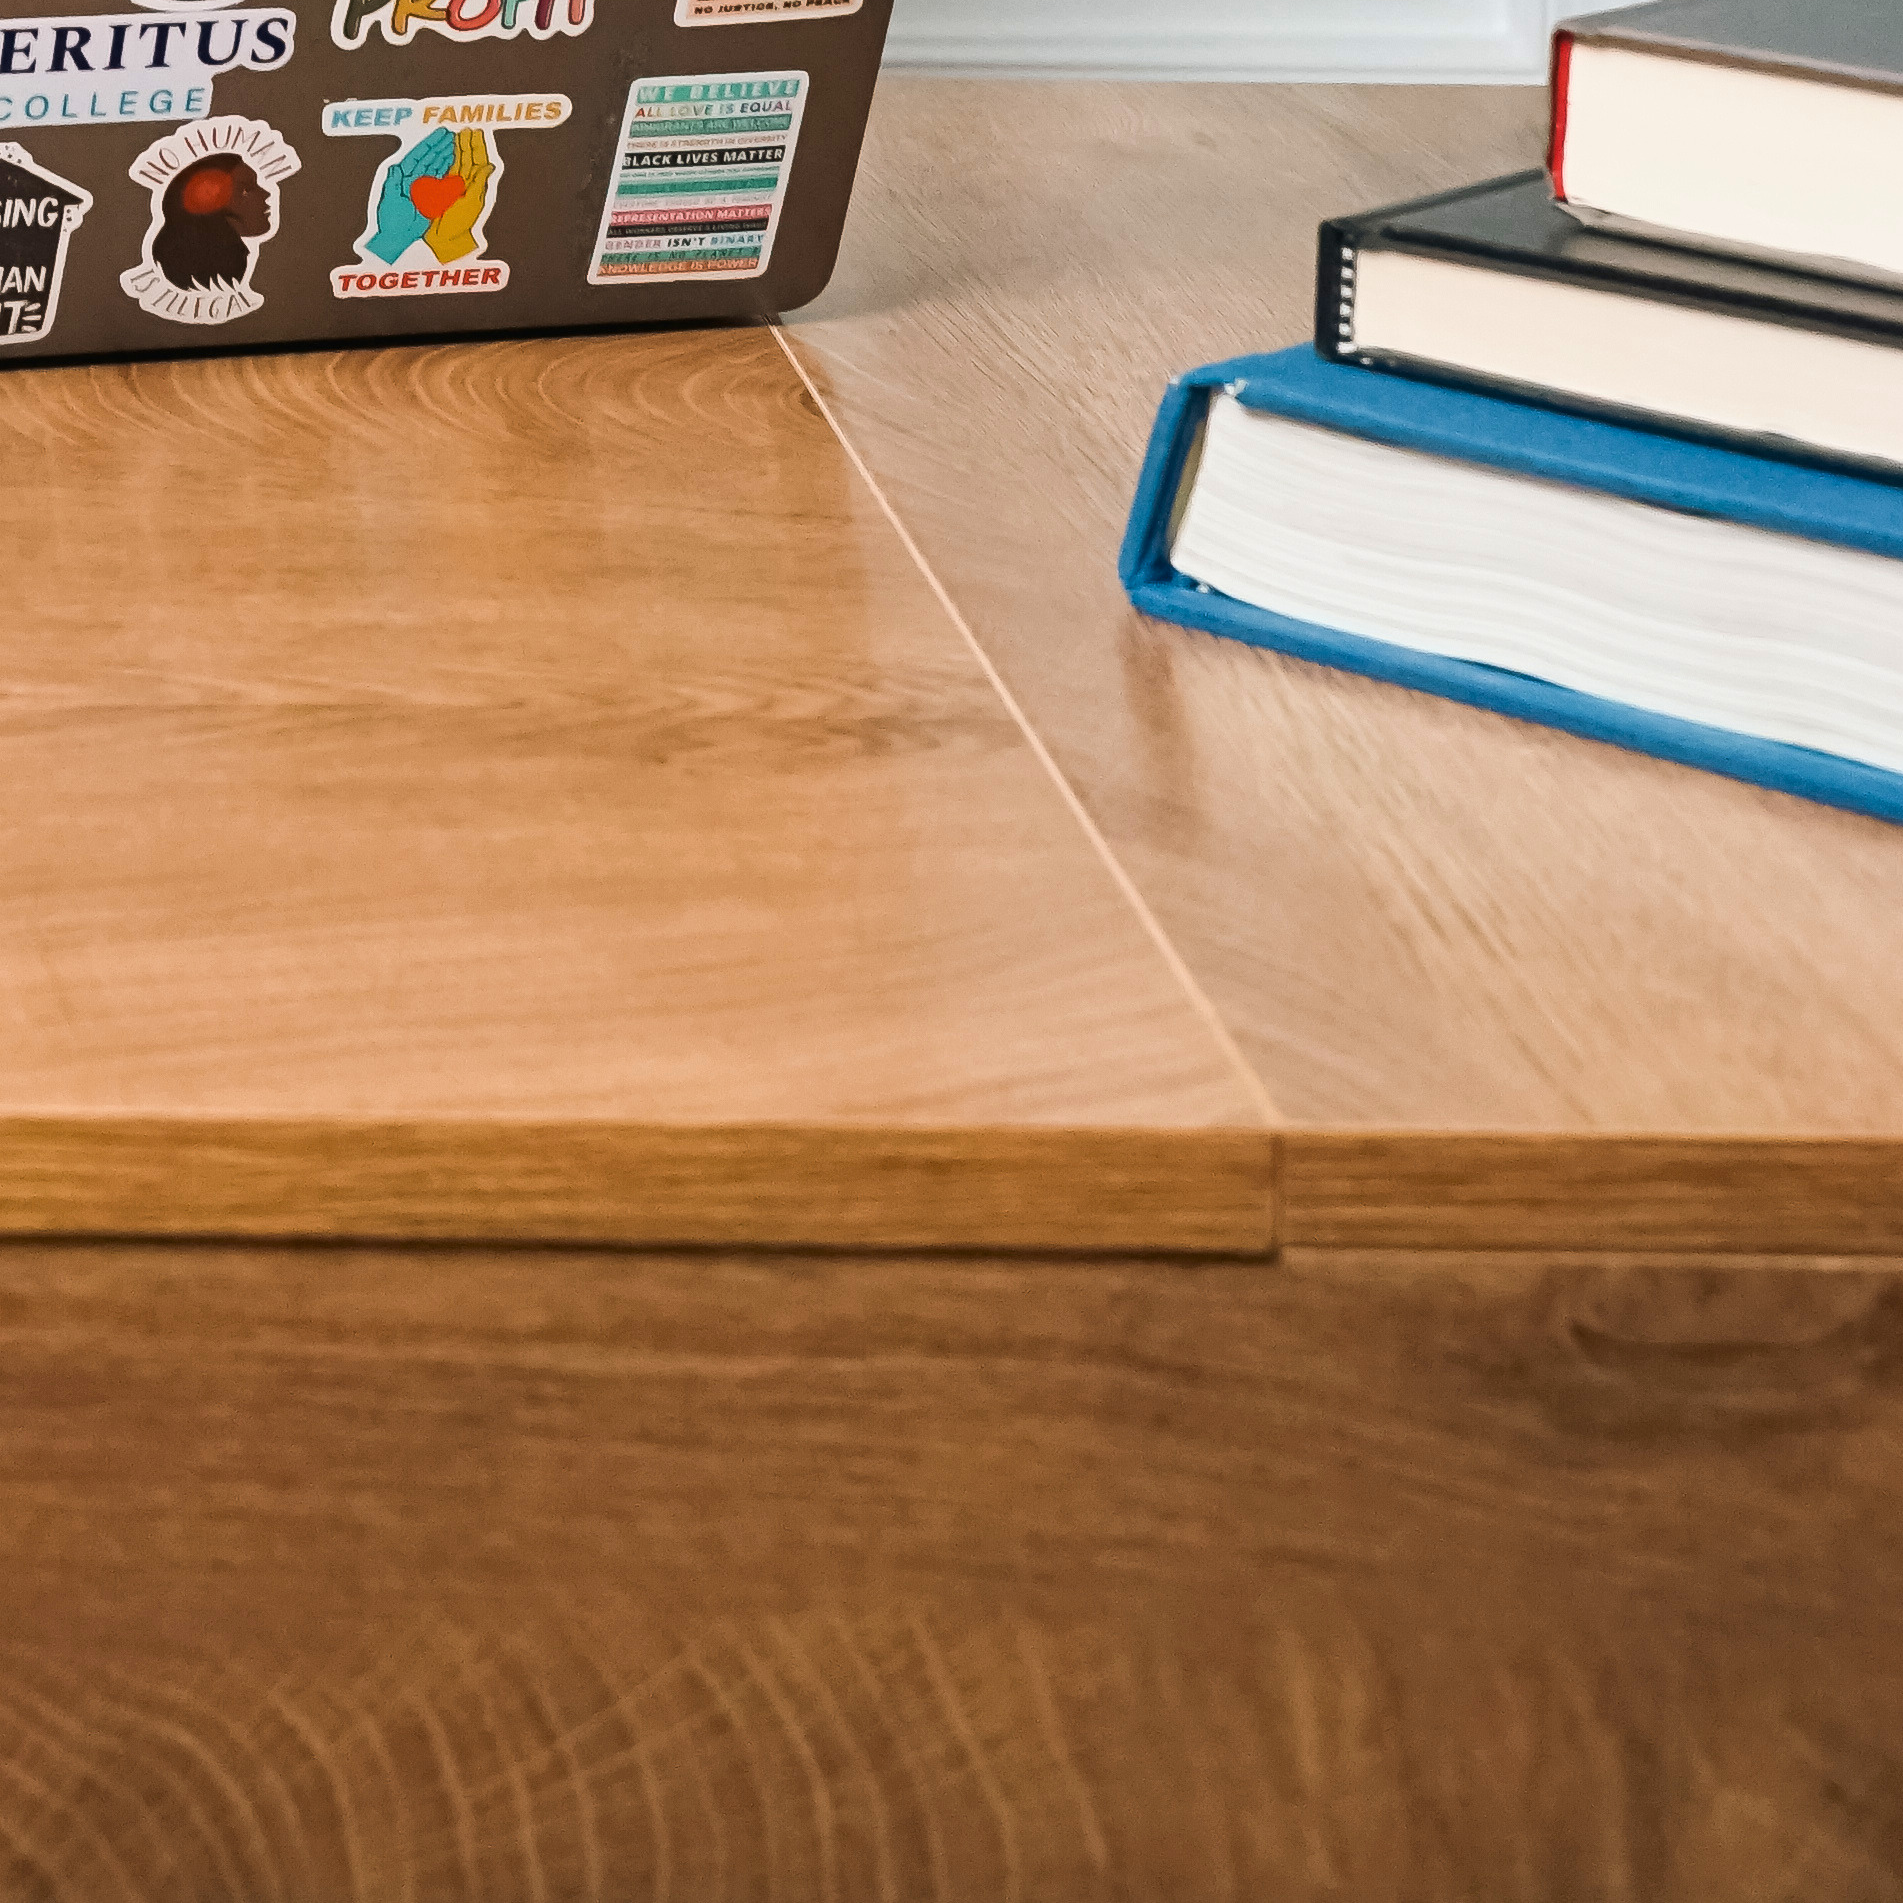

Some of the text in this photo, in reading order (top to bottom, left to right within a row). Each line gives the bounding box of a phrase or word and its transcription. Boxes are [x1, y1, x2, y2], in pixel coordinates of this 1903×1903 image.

[694, 5, 713, 14] NO
[783, 0, 802, 8] NO
[637, 80, 797, 102] WE BELIEVE
[331, 101, 563, 128] KEEP FAMILIES
[635, 100, 793, 118] ALL LOVE IS EQUAL
[139, 124, 293, 185] NO HUMAN
[622, 148, 783, 167] BLACK LIVES MATTER
[666, 236, 706, 247] ISN'T
[709, 234, 764, 244] BINARY
[130, 268, 161, 293] IS
[339, 267, 502, 292] TOGETHER
